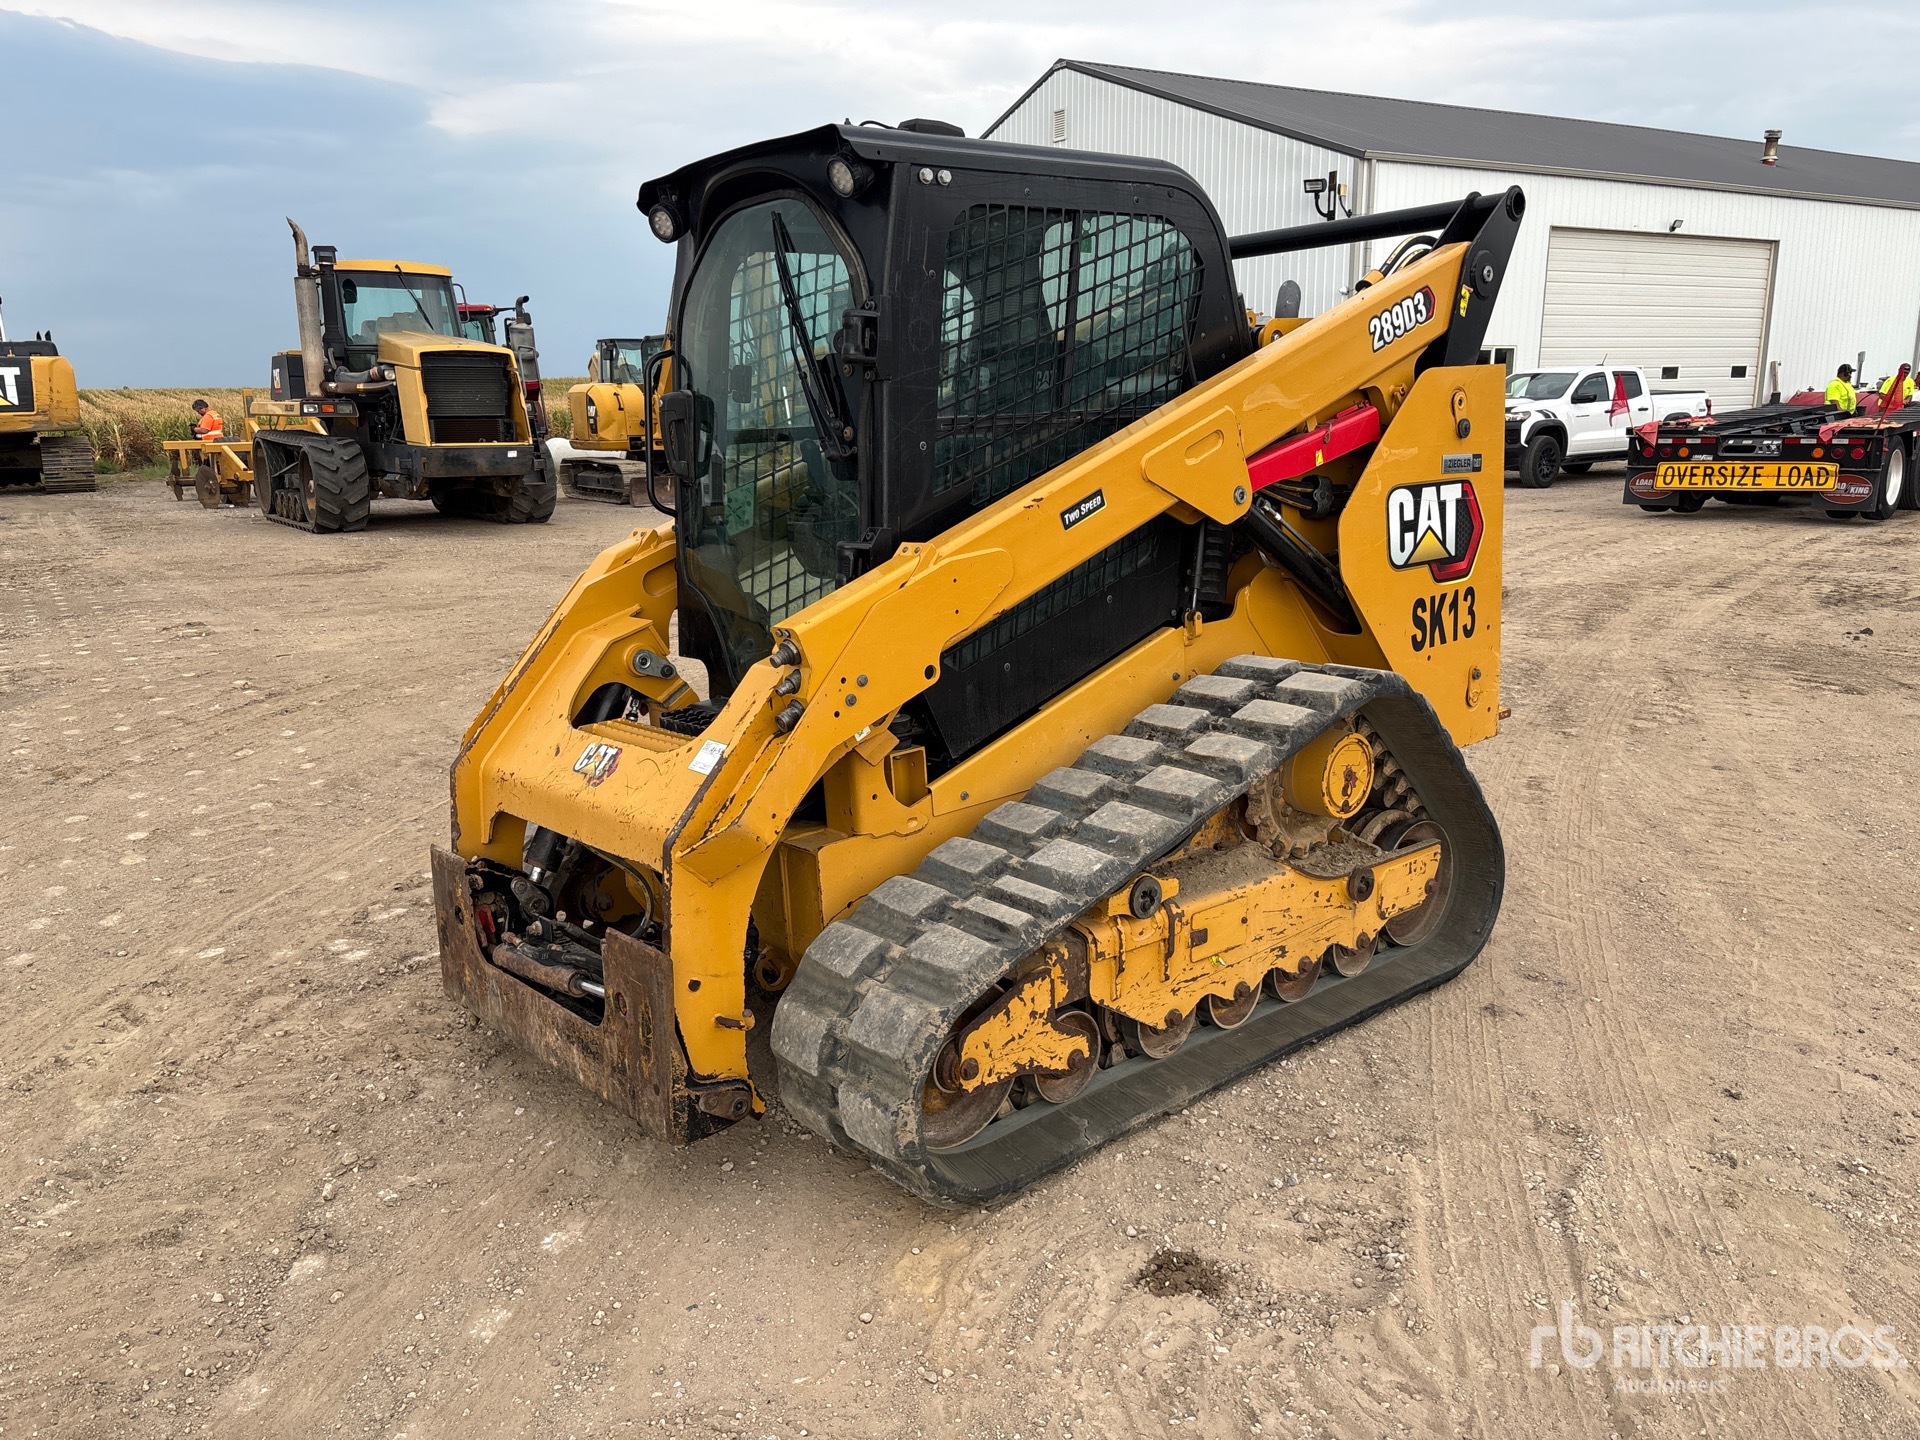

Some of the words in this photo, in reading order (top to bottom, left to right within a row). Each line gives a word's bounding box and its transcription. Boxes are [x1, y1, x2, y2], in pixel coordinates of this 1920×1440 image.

[1369, 291, 1428, 352] 289D3
[1448, 458, 1471, 468] ZIEGLER
[1662, 465, 1765, 487] OVERSIZE
[1775, 465, 1830, 487] LOAD
[1635, 478, 1653, 486] LOAD
[1850, 486, 1870, 494] KING
[1388, 482, 1463, 567] CAT
[1410, 586, 1476, 653] SK13
[574, 743, 618, 776] CAT
